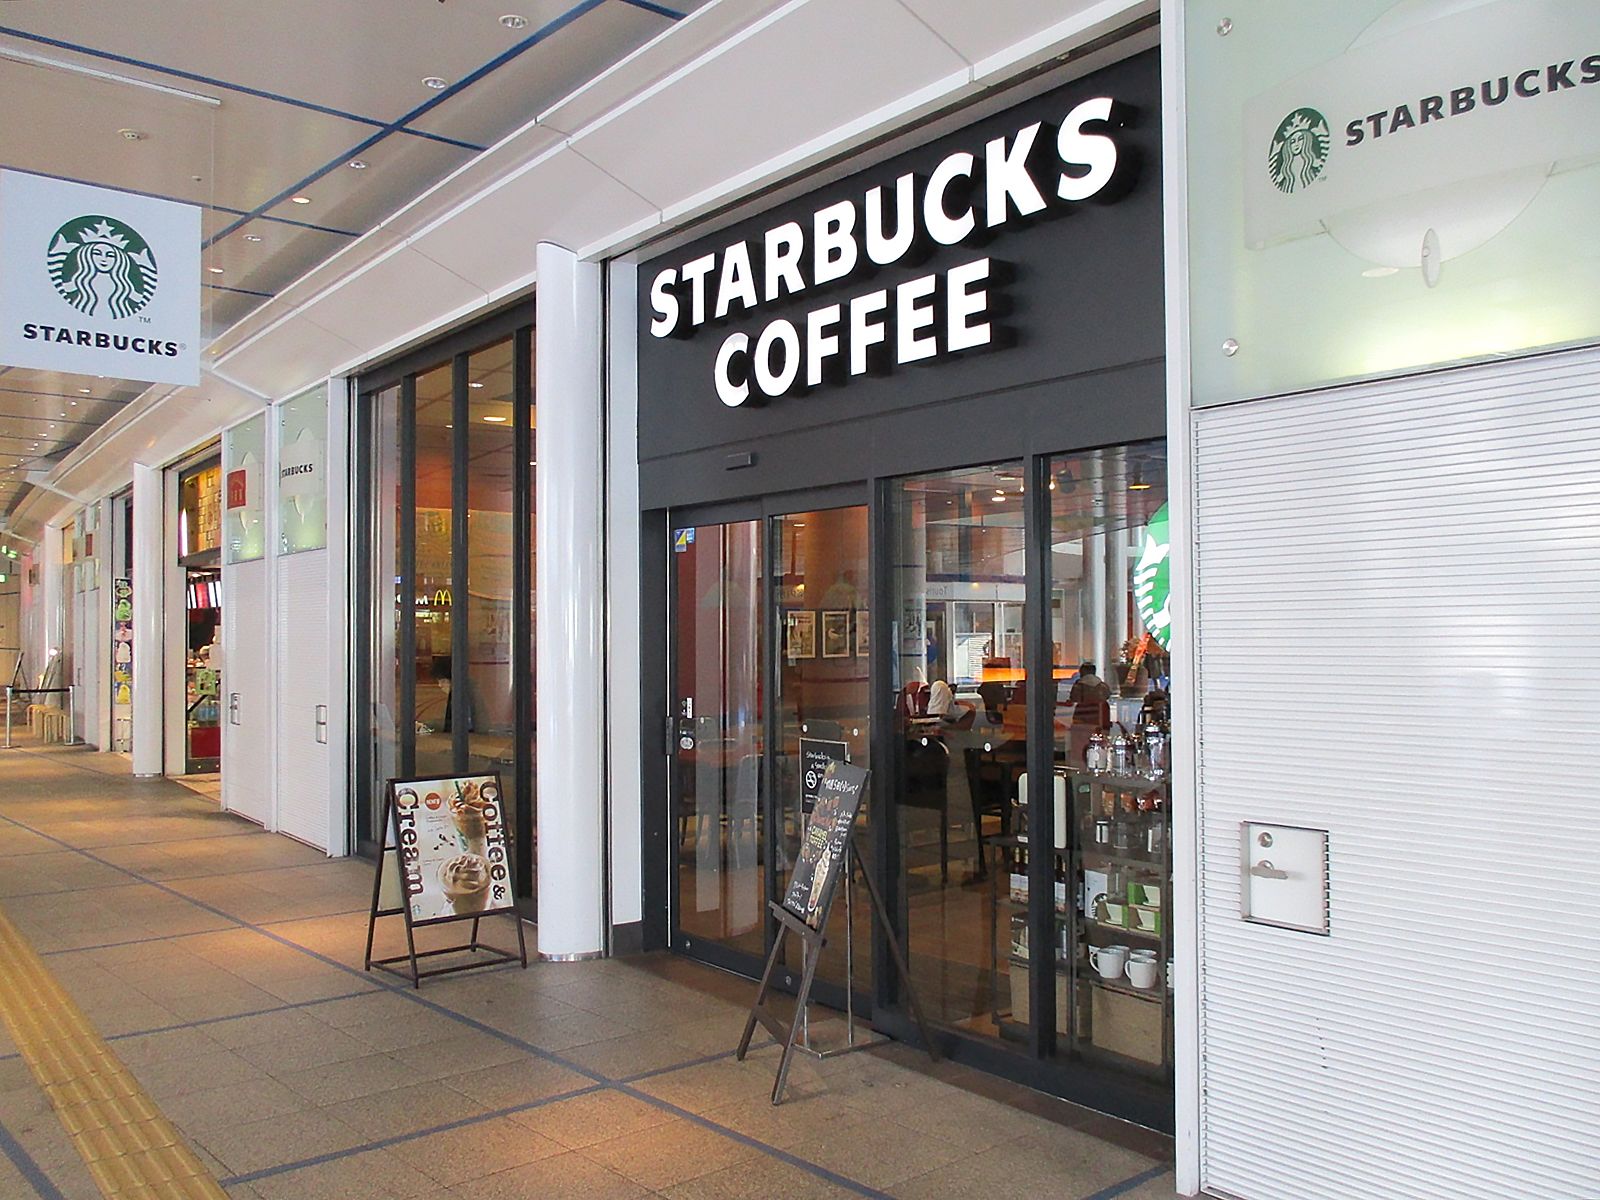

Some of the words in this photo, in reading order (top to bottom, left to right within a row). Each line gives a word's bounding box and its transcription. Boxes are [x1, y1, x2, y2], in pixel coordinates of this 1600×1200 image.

[1345, 54, 1600, 147] STARBUCKS
[650, 97, 1119, 338] STARBUCKS
[23, 323, 178, 357] STARBUCKS
[714, 257, 991, 408] COFFEE
[397, 788, 424, 898] Cream
[480, 781, 506, 881] Coffee
[492, 884, 506, 900] &
